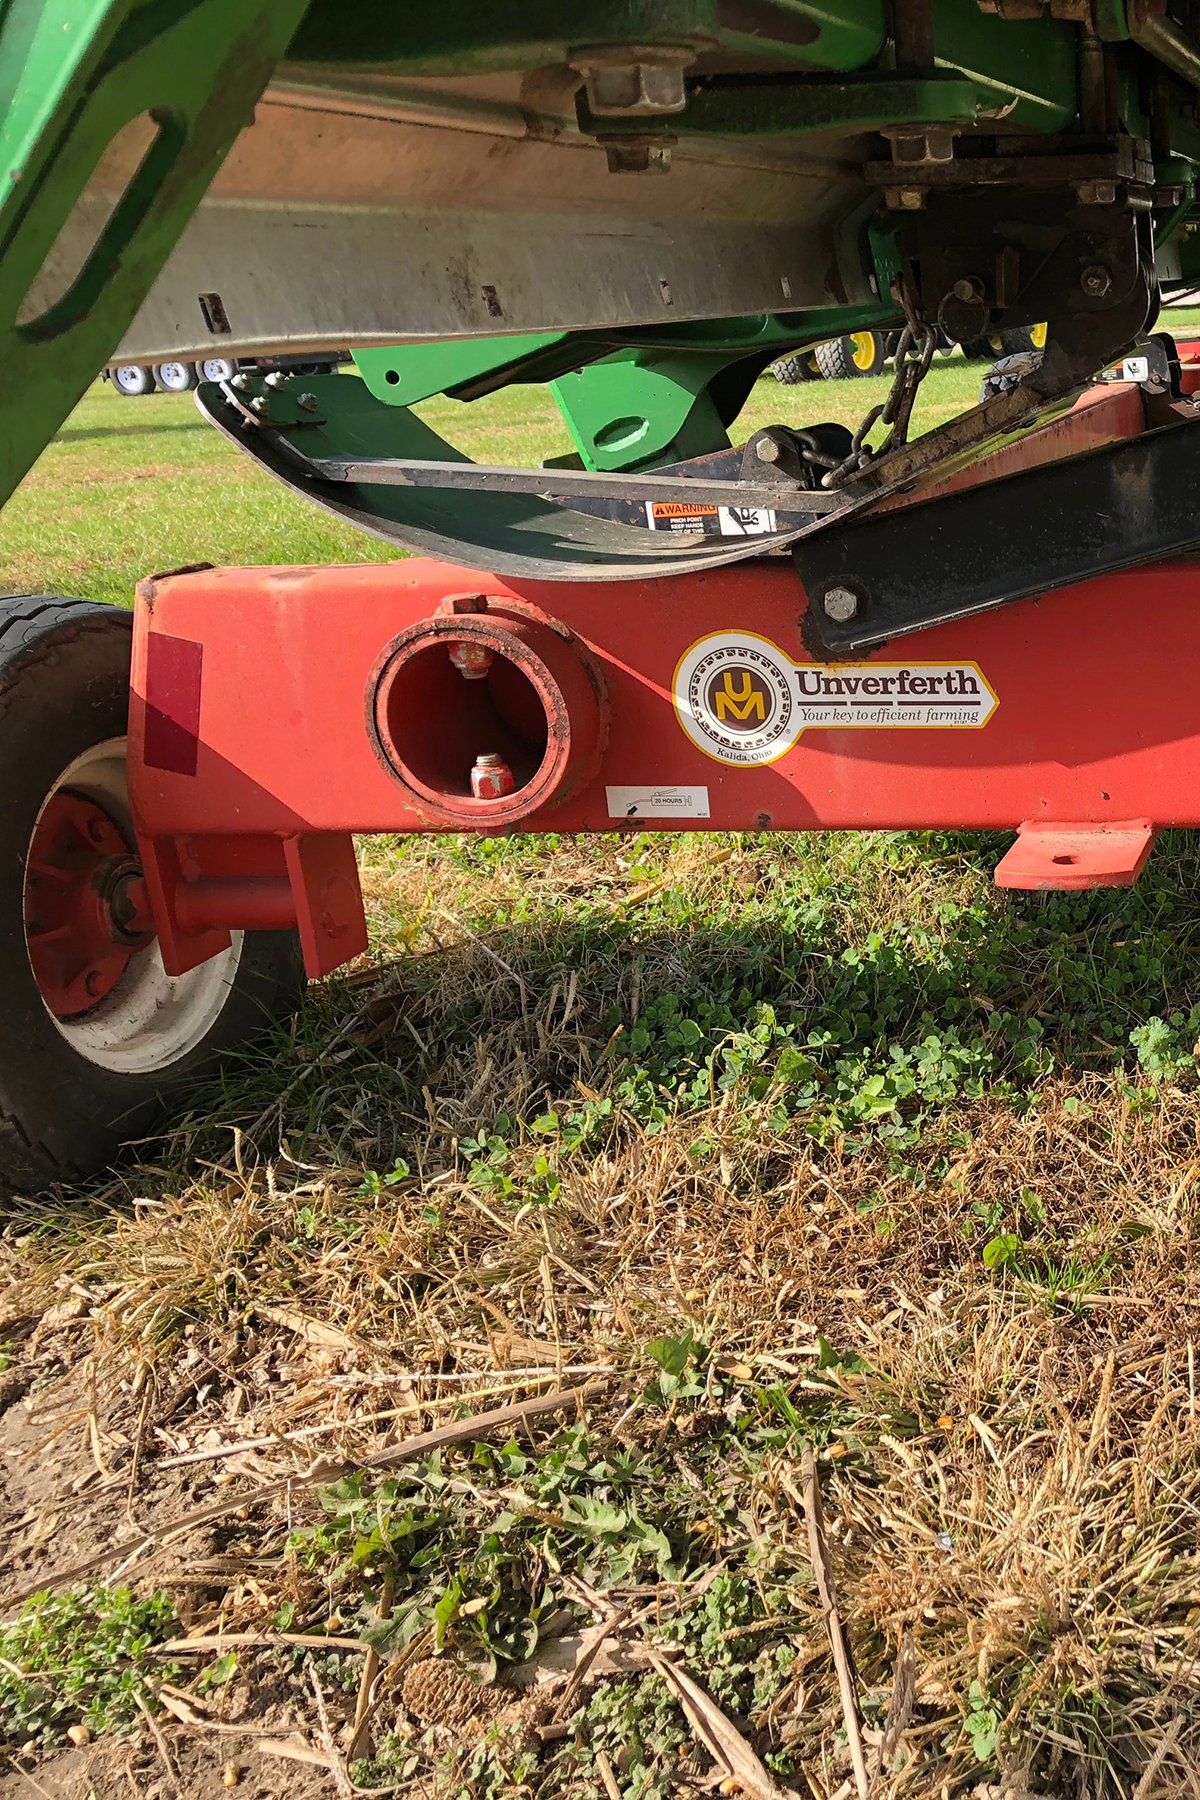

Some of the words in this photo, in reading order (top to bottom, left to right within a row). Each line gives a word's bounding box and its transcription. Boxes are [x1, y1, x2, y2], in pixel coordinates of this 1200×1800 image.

[664, 504, 715, 514] WARNING
[794, 670, 980, 695] Unverferth
[801, 708, 830, 721] Your
[833, 708, 854, 723] key
[856, 709, 868, 721] to
[871, 708, 921, 723] efficient
[926, 708, 979, 723] farming
[717, 748, 750, 762] Kalida,
[751, 749, 772, 760] Ohio
